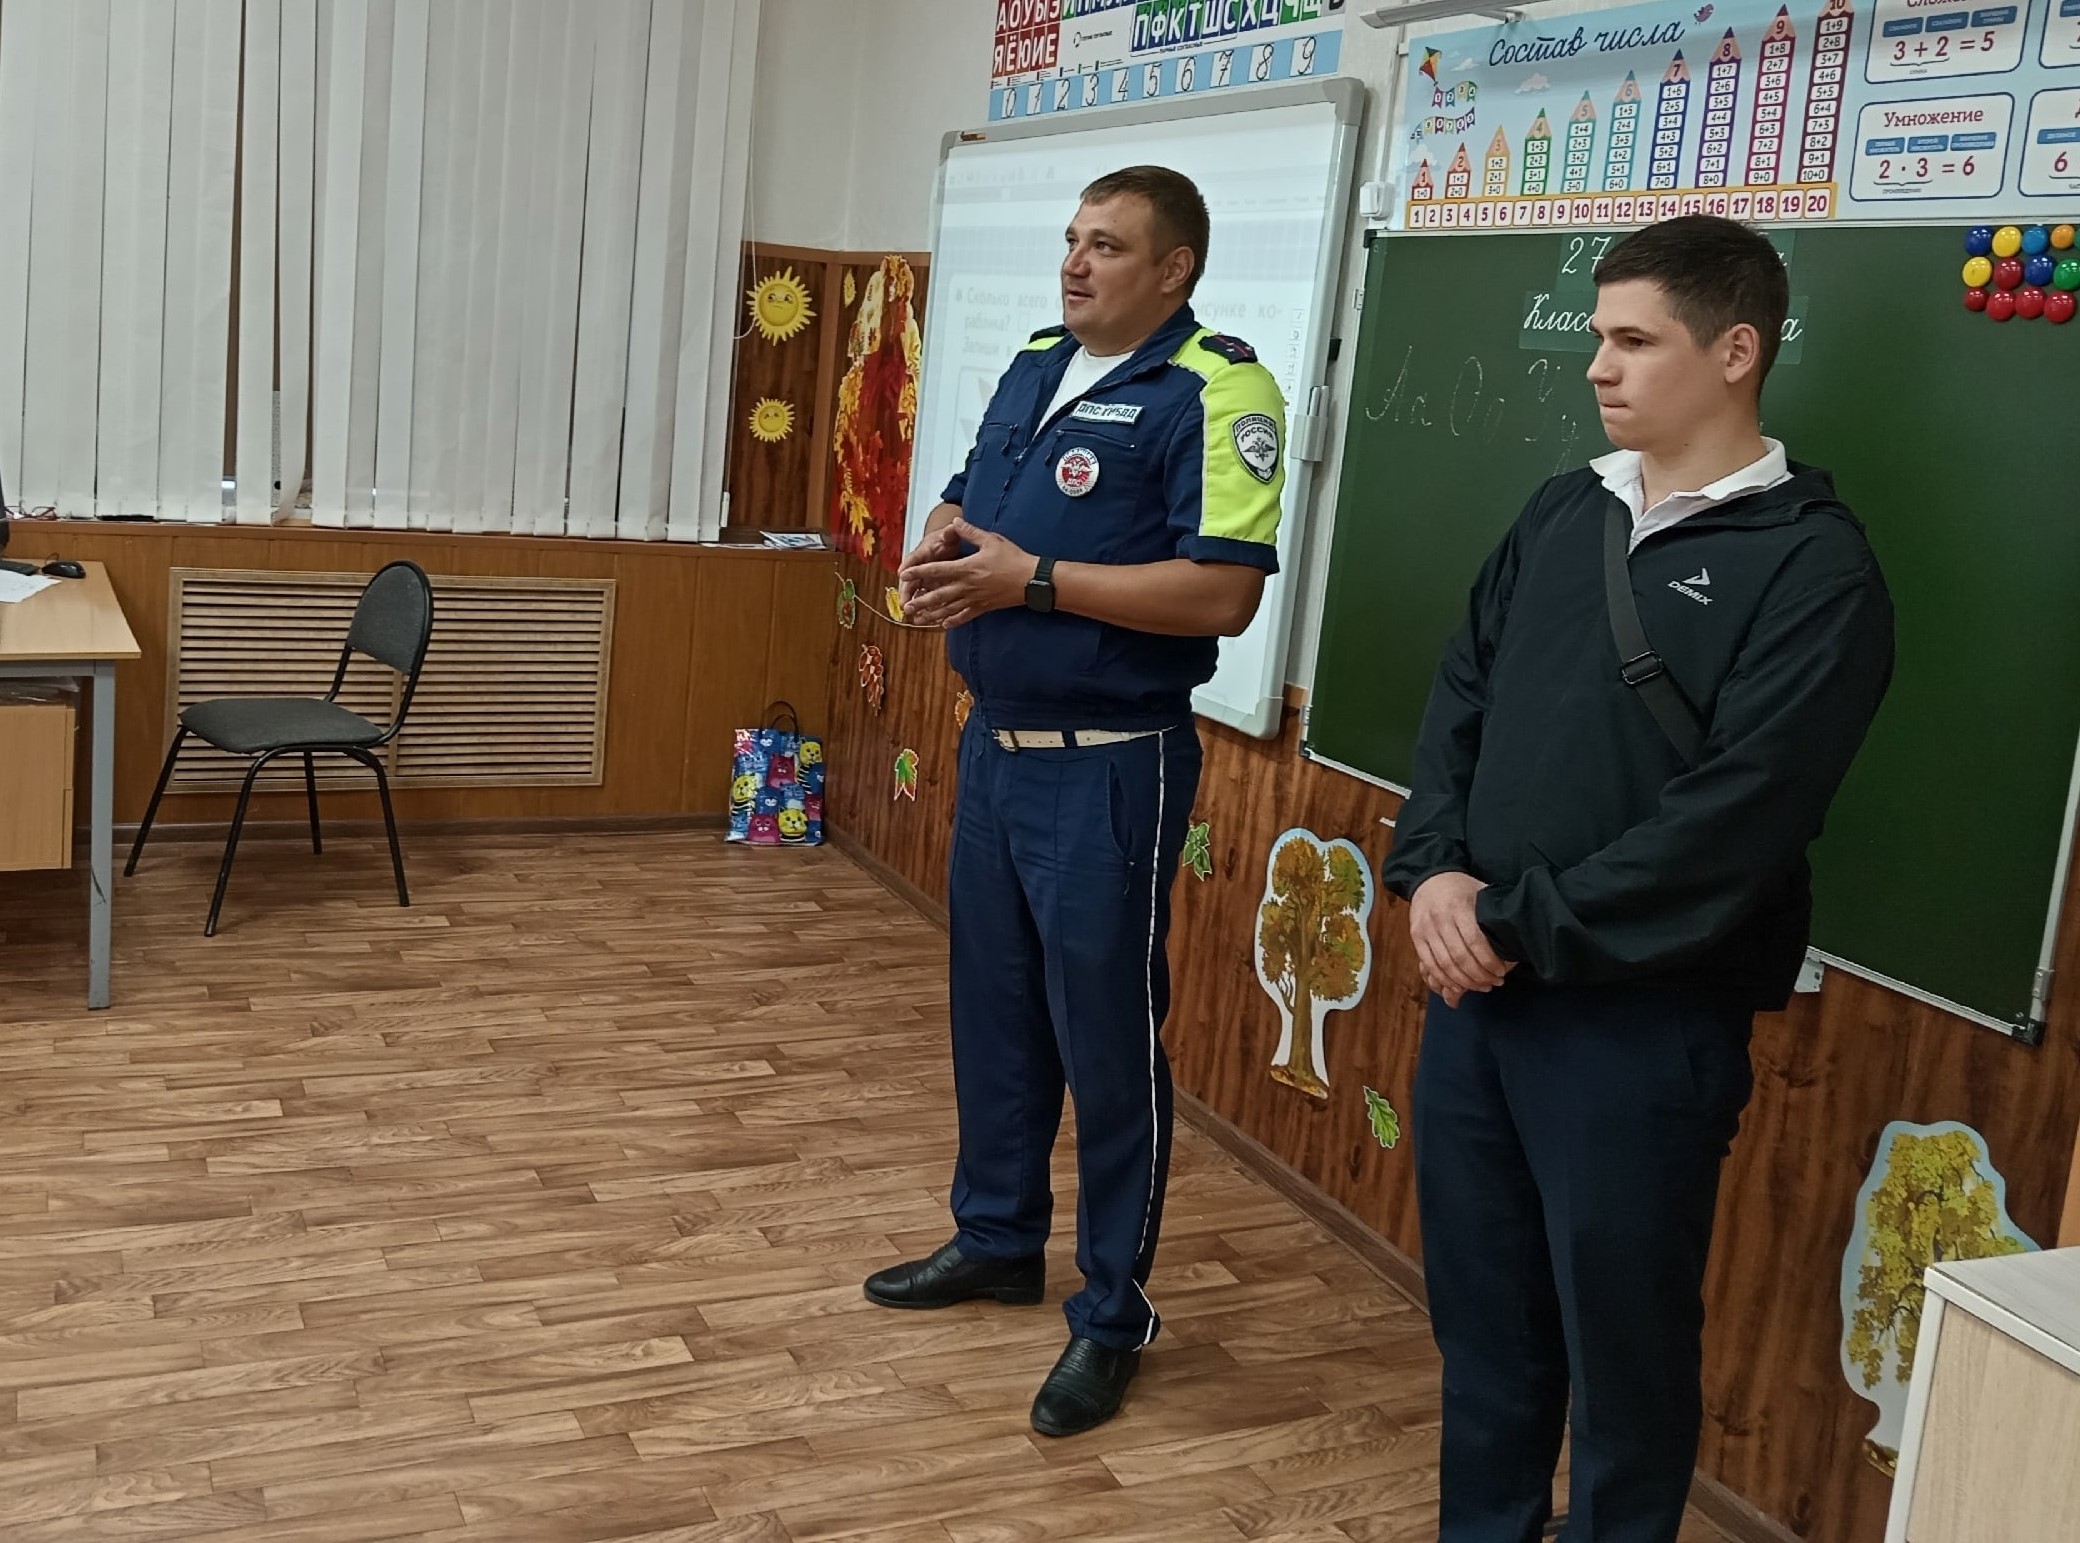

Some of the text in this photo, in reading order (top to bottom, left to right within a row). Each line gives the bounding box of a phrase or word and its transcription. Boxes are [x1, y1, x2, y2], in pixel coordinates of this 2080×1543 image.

[1776, 23, 1784, 34] 9
[1825, 20, 1843, 32] 1+9
[1489, 21, 1686, 67] Состав числа
[1823, 37, 1841, 48] 2+8
[1893, 41, 1906, 60] 3
[1935, 36, 1949, 57] 2
[1980, 31, 1995, 51] 5
[1722, 44, 1731, 56] 8
[1769, 44, 1786, 54] 1+8
[1820, 53, 1839, 64] 3+7
[1673, 64, 1680, 76] 7
[1716, 65, 1733, 75] 1+7
[1767, 60, 1784, 70] 2+7
[1005, 87, 1016, 118] 0
[1034, 82, 1043, 113] 1
[1057, 79, 1070, 111] 2
[1085, 73, 1099, 106] 3
[1118, 68, 1129, 101] 4
[1146, 63, 1161, 96] 5
[1181, 57, 1196, 92] 6
[1218, 50, 1234, 86] 7
[1256, 44, 1274, 80] 8
[1298, 36, 1316, 75] 9
[1818, 70, 1836, 80] 4+6
[1715, 81, 1731, 91] 2+6
[1765, 76, 1781, 86] 3+6
[1667, 87, 1682, 96] 1+6
[1763, 91, 1779, 102] 4+5
[1816, 87, 1834, 96] 5+5
[1664, 102, 1680, 111] 2+5
[1713, 97, 1729, 106] 3+5
[1761, 108, 1778, 118] 5+4
[1814, 103, 1831, 113] 6+4
[1663, 117, 1678, 126] 3+4
[1711, 113, 1727, 122] 4+4
[1884, 110, 1984, 127] Умножение
[1759, 124, 1775, 134] 6+3
[1812, 120, 1829, 130] 7+3
[1661, 132, 1676, 141] 4+3
[1708, 128, 1725, 138] 5+3
[1757, 140, 1774, 150] 7+2
[1810, 136, 1827, 146] 8+2
[1658, 147, 1674, 156] 5+2
[1706, 144, 1723, 154] 6+2
[1755, 156, 1771, 166] 8+1
[1808, 153, 1825, 163] 9+1
[2054, 152, 2068, 172] 6
[1656, 162, 1671, 171] 6+1
[1704, 159, 1720, 169] 7+1
[1879, 160, 1890, 179] 2
[1916, 158, 1928, 177] 3
[1962, 156, 1975, 176] 6
[1703, 174, 1719, 184] 8+0
[1753, 172, 1770, 182] 9+0
[1802, 169, 1825, 180] 10+0
[1655, 177, 1671, 186] 7+0
[1414, 195, 1827, 223] 1 2 3 4 5 6 7 8 9 10 11 12 13 14 15 16 17 18 19 20
[1077, 403, 1101, 416] ДПС
